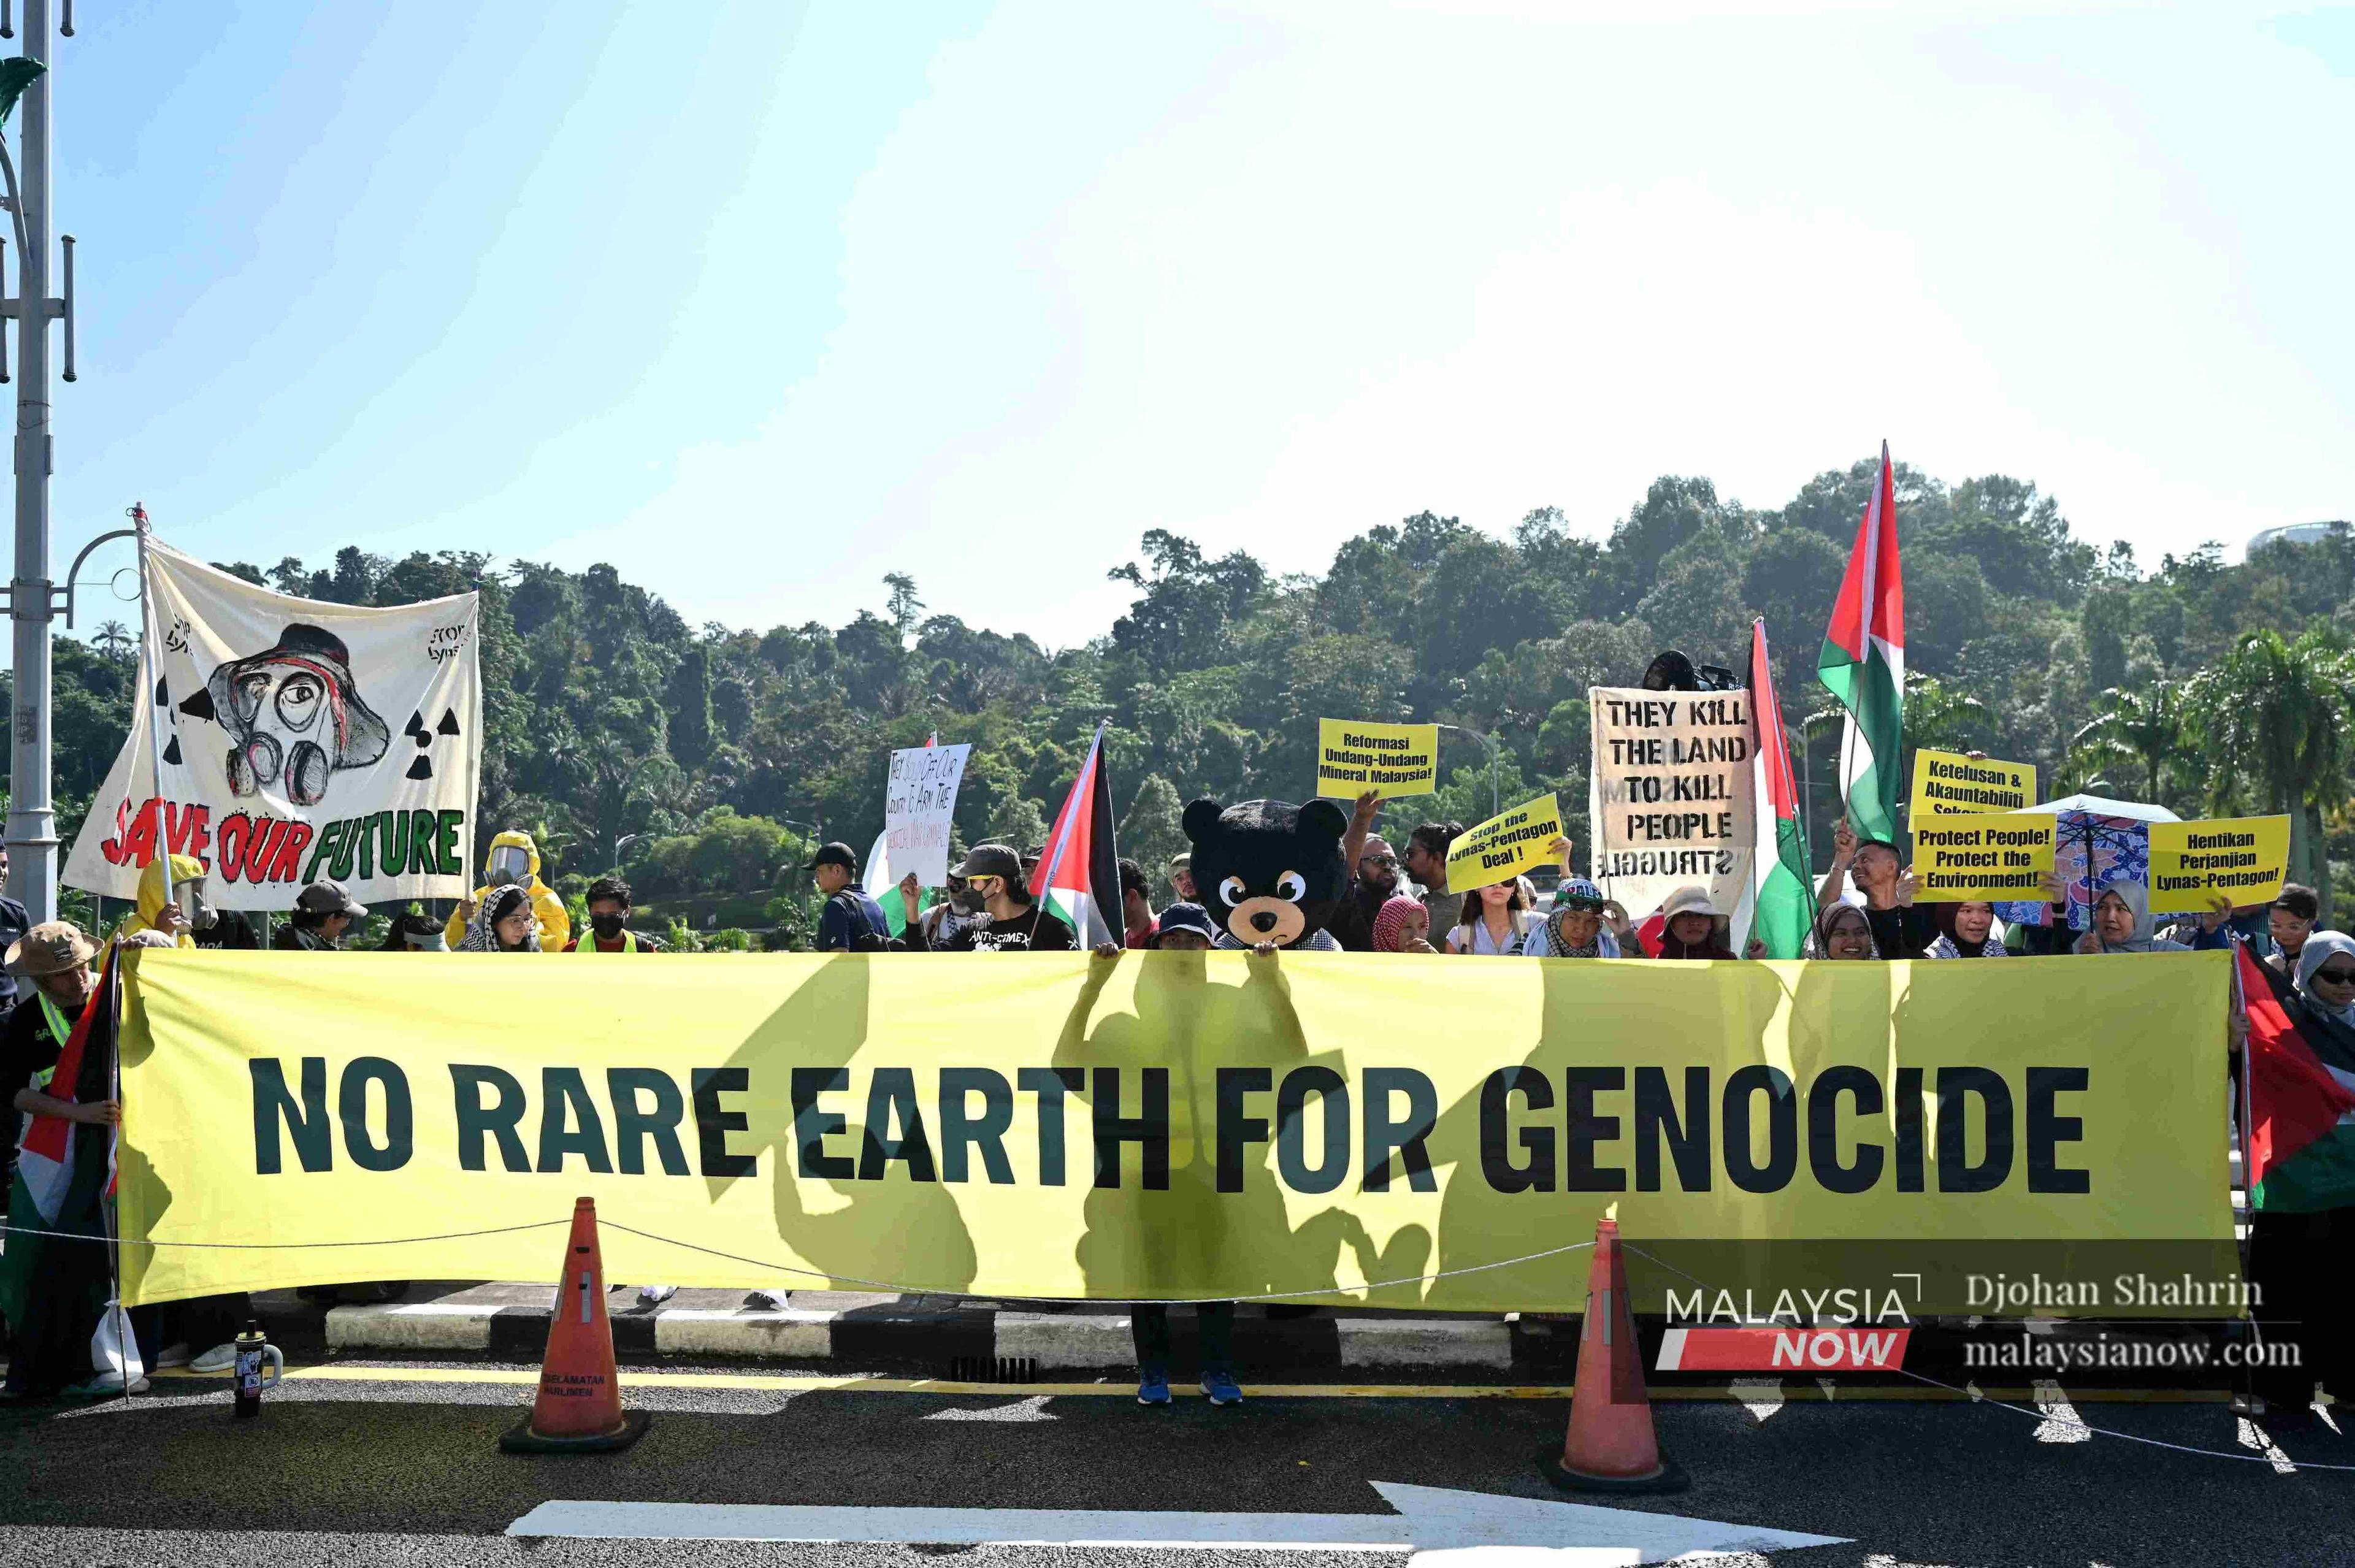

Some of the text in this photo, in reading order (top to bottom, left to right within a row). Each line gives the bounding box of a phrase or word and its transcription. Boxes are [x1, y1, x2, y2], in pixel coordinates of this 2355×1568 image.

[1606, 699, 1747, 728] THEY KILL
[1343, 733, 1409, 750] Reformasi
[1609, 736, 1747, 765] THE LAND
[1325, 748, 1428, 767] Undang-Undang
[1319, 764, 1432, 783] Mineral Malaysia!
[1929, 760, 2022, 788] Ketelusan &
[1623, 776, 1661, 803] TO
[1673, 774, 1733, 801] KILL
[1925, 781, 2024, 809] Akauntabiliti
[1470, 812, 1528, 841] Stop the
[1627, 813, 1733, 841] PEOPLE
[1919, 828, 2050, 846] Protect People!
[101, 797, 464, 885] SAVE OUR FUTURE
[1449, 820, 1558, 862] Lynas-Pentagon
[2188, 832, 2254, 849] Hentikan
[1481, 849, 1514, 869] Deal
[1936, 851, 2031, 866] Protect the
[2180, 852, 2256, 870] Perjanjian
[1927, 871, 2038, 888] Environment!
[2157, 867, 2280, 891] Lynas-Pentagon!
[248, 1055, 2091, 1195] NO RARE EARTH FOR GENOCIDE
